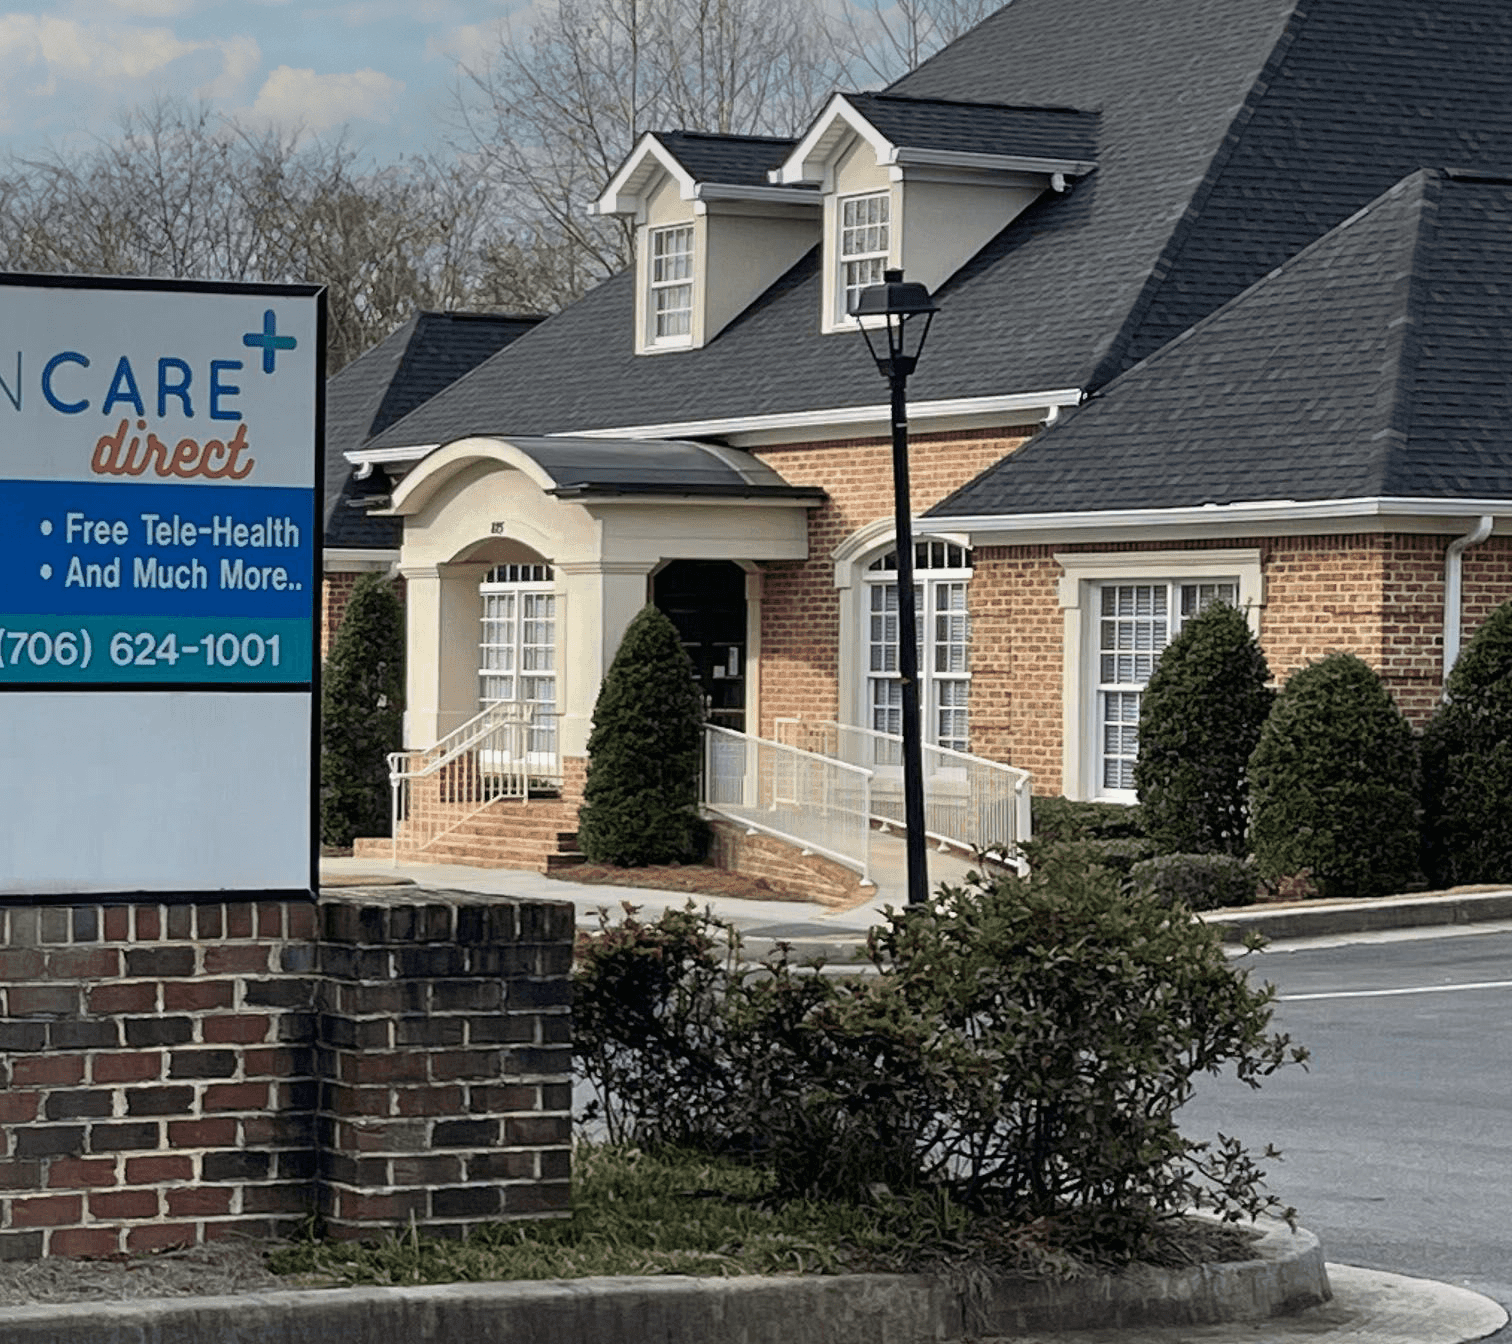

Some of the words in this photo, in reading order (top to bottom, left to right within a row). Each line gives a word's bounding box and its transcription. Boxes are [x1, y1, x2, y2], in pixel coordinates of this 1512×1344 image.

[91, 419, 255, 480] direct
[65, 512, 129, 546] Free
[141, 514, 300, 548] Tele-Health
[64, 556, 121, 589] And
[133, 557, 208, 591] Much
[109, 632, 281, 667] 624-1001
